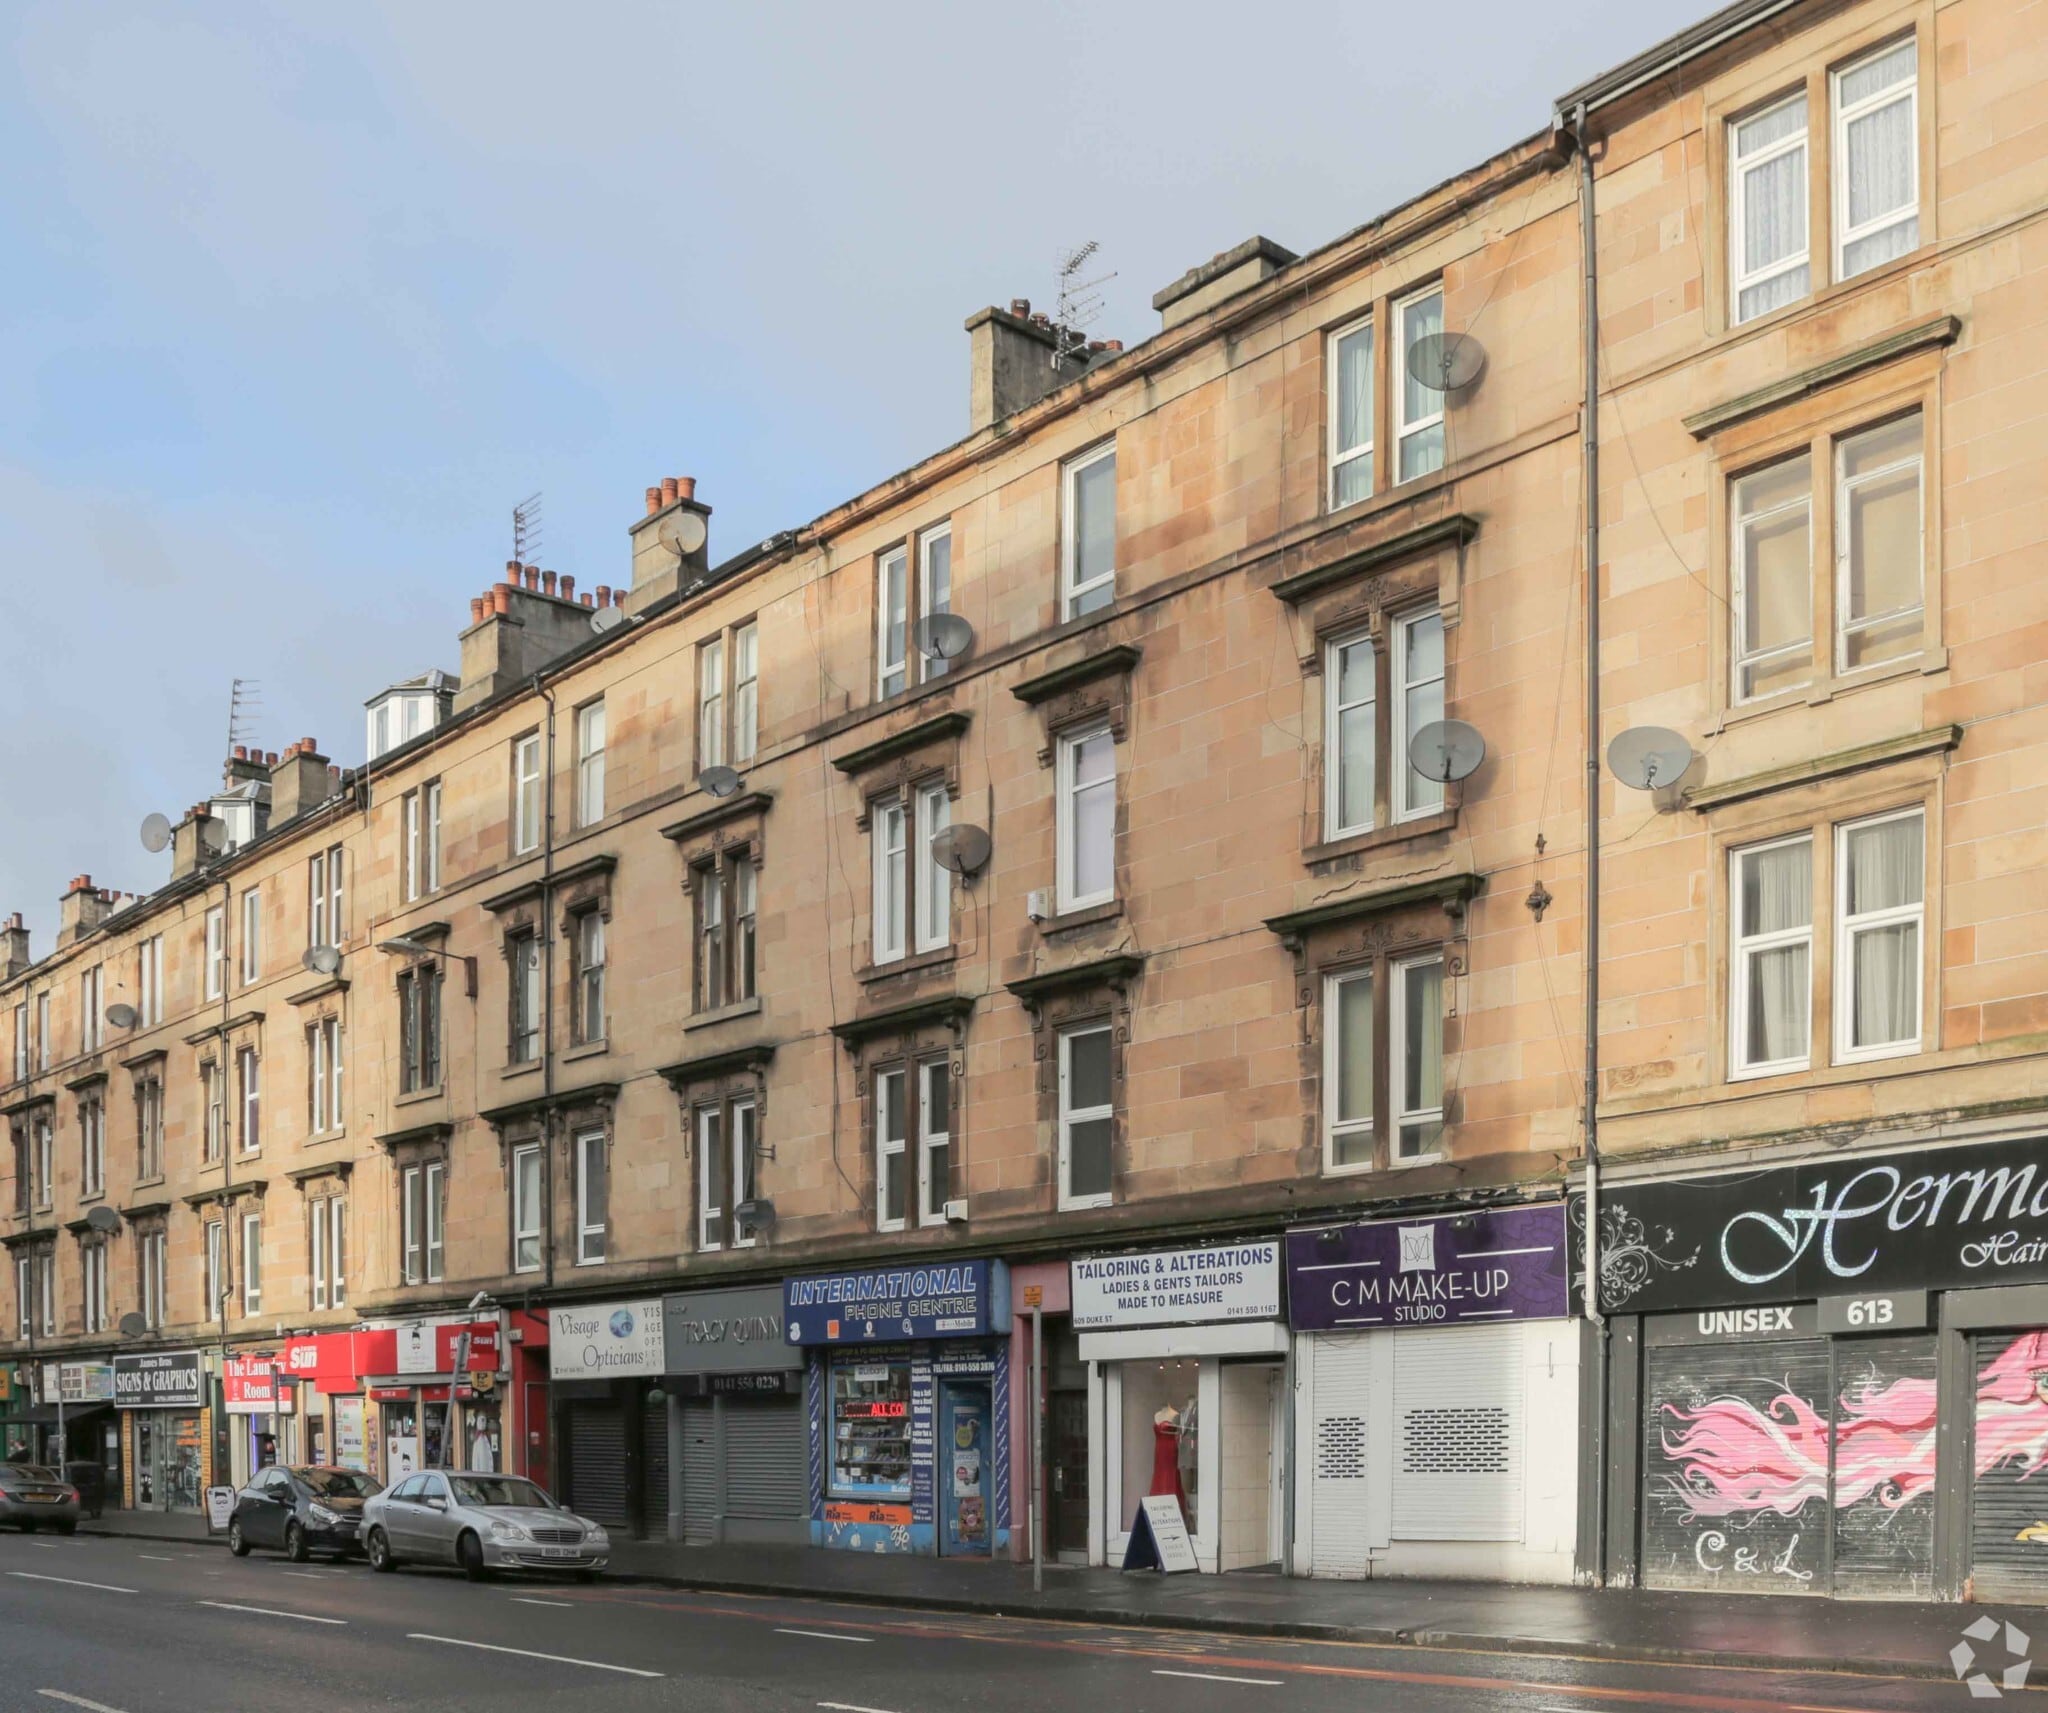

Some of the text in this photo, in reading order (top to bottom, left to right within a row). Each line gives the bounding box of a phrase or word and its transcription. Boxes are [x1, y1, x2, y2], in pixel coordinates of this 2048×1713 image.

[1077, 1247, 1273, 1279] TAILORING & ALTERATIONS
[790, 1267, 976, 1306] INTERNATIONAL
[1102, 1272, 1243, 1294] LADIES & GENTS TAILORS
[1332, 1269, 1508, 1306] C M MAKE-UP
[845, 1296, 976, 1321] PHONE CENTRE
[1118, 1291, 1223, 1310] MADE TO MEASURE
[1227, 1308, 1243, 1316] 0141
[1105, 1315, 1112, 1323] ST
[1394, 1304, 1447, 1321] STUDIO
[1698, 1307, 1794, 1335] UNISEX
[1847, 1299, 1893, 1326] 613
[559, 1314, 599, 1339] Visage
[682, 1316, 781, 1345] TRACY QUINN
[227, 1359, 244, 1377] The
[290, 1346, 317, 1369] Sun
[583, 1345, 644, 1372] Opticians
[116, 1372, 141, 1392] SIGNS
[143, 1371, 151, 1391] &
[152, 1368, 197, 1391] GRAPHICS
[243, 1382, 271, 1399] Room
[826, 1507, 841, 1520] Ria
[869, 1508, 885, 1521] Ria
